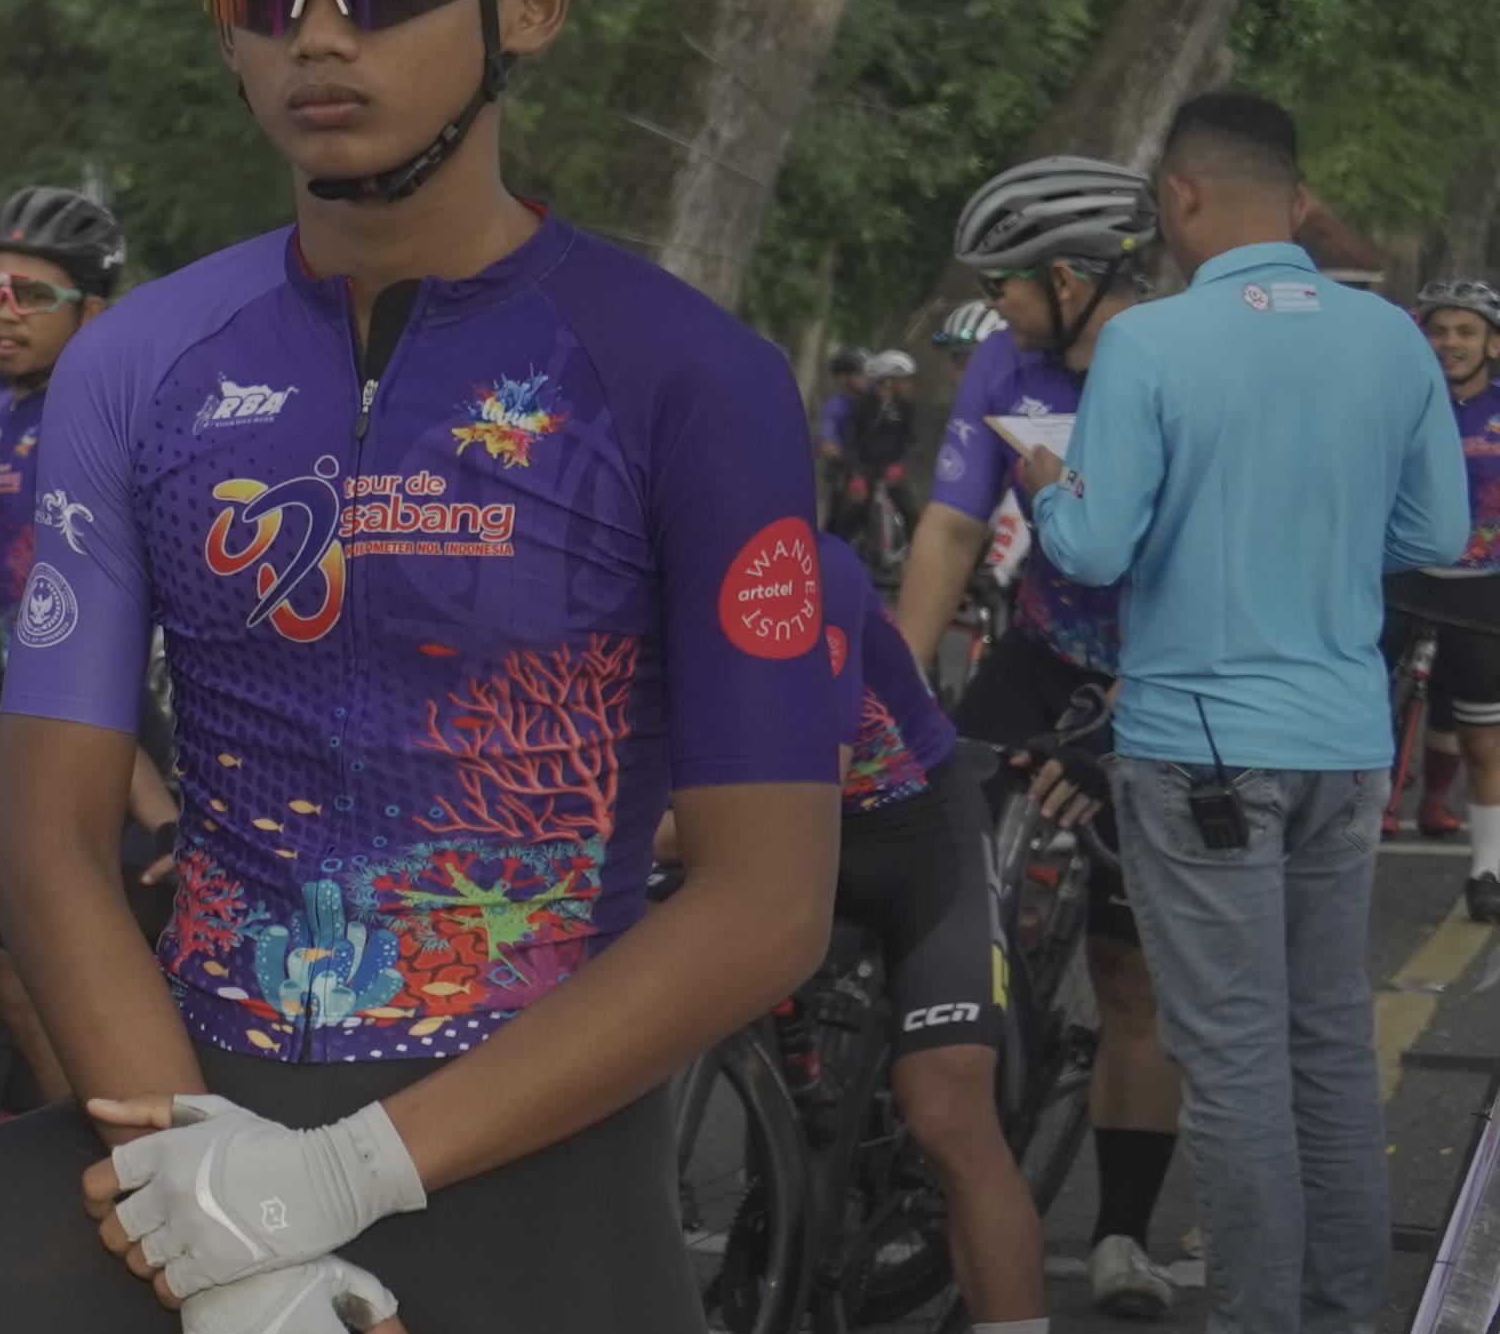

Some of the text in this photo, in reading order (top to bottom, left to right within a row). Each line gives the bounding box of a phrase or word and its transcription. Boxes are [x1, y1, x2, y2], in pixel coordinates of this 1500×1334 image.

[211, 391, 288, 420] RBA
[344, 471, 446, 498] tour de
[338, 496, 515, 542] sabang
[416, 541, 442, 556] NOL
[443, 541, 514, 556] INDONESIA
[738, 580, 793, 602] artotel
[741, 539, 816, 642] WANDERLUST
